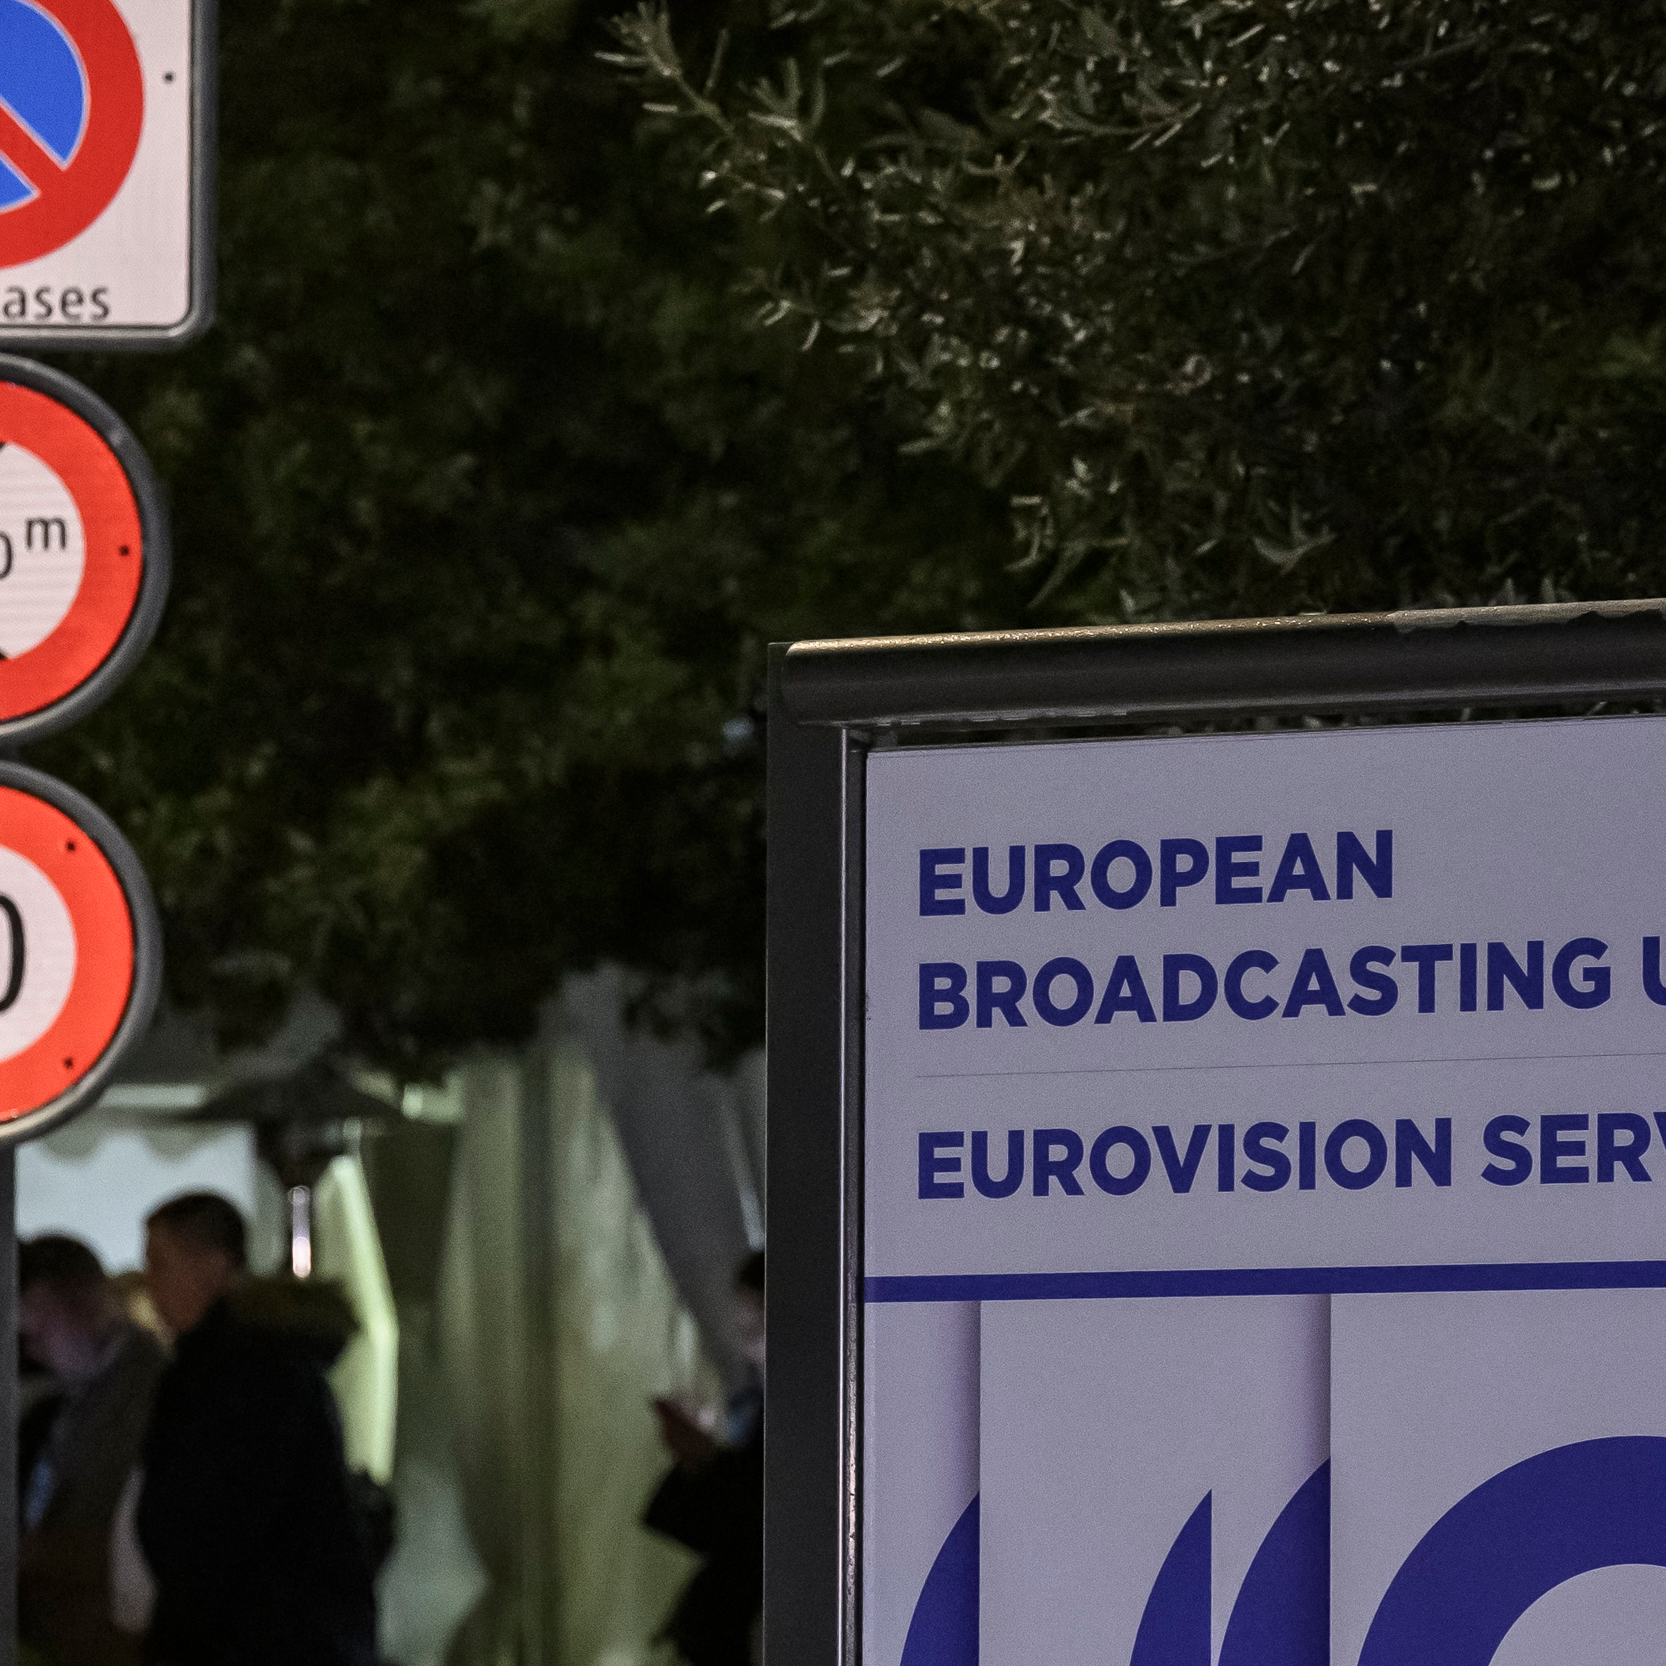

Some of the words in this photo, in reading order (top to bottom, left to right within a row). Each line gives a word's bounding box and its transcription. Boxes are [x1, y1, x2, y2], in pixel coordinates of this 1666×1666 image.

[919, 830, 1393, 916] EUROPEAN
[919, 937, 1611, 1029] BROADCASTING
[919, 1118, 1452, 1199] EUROVISION
